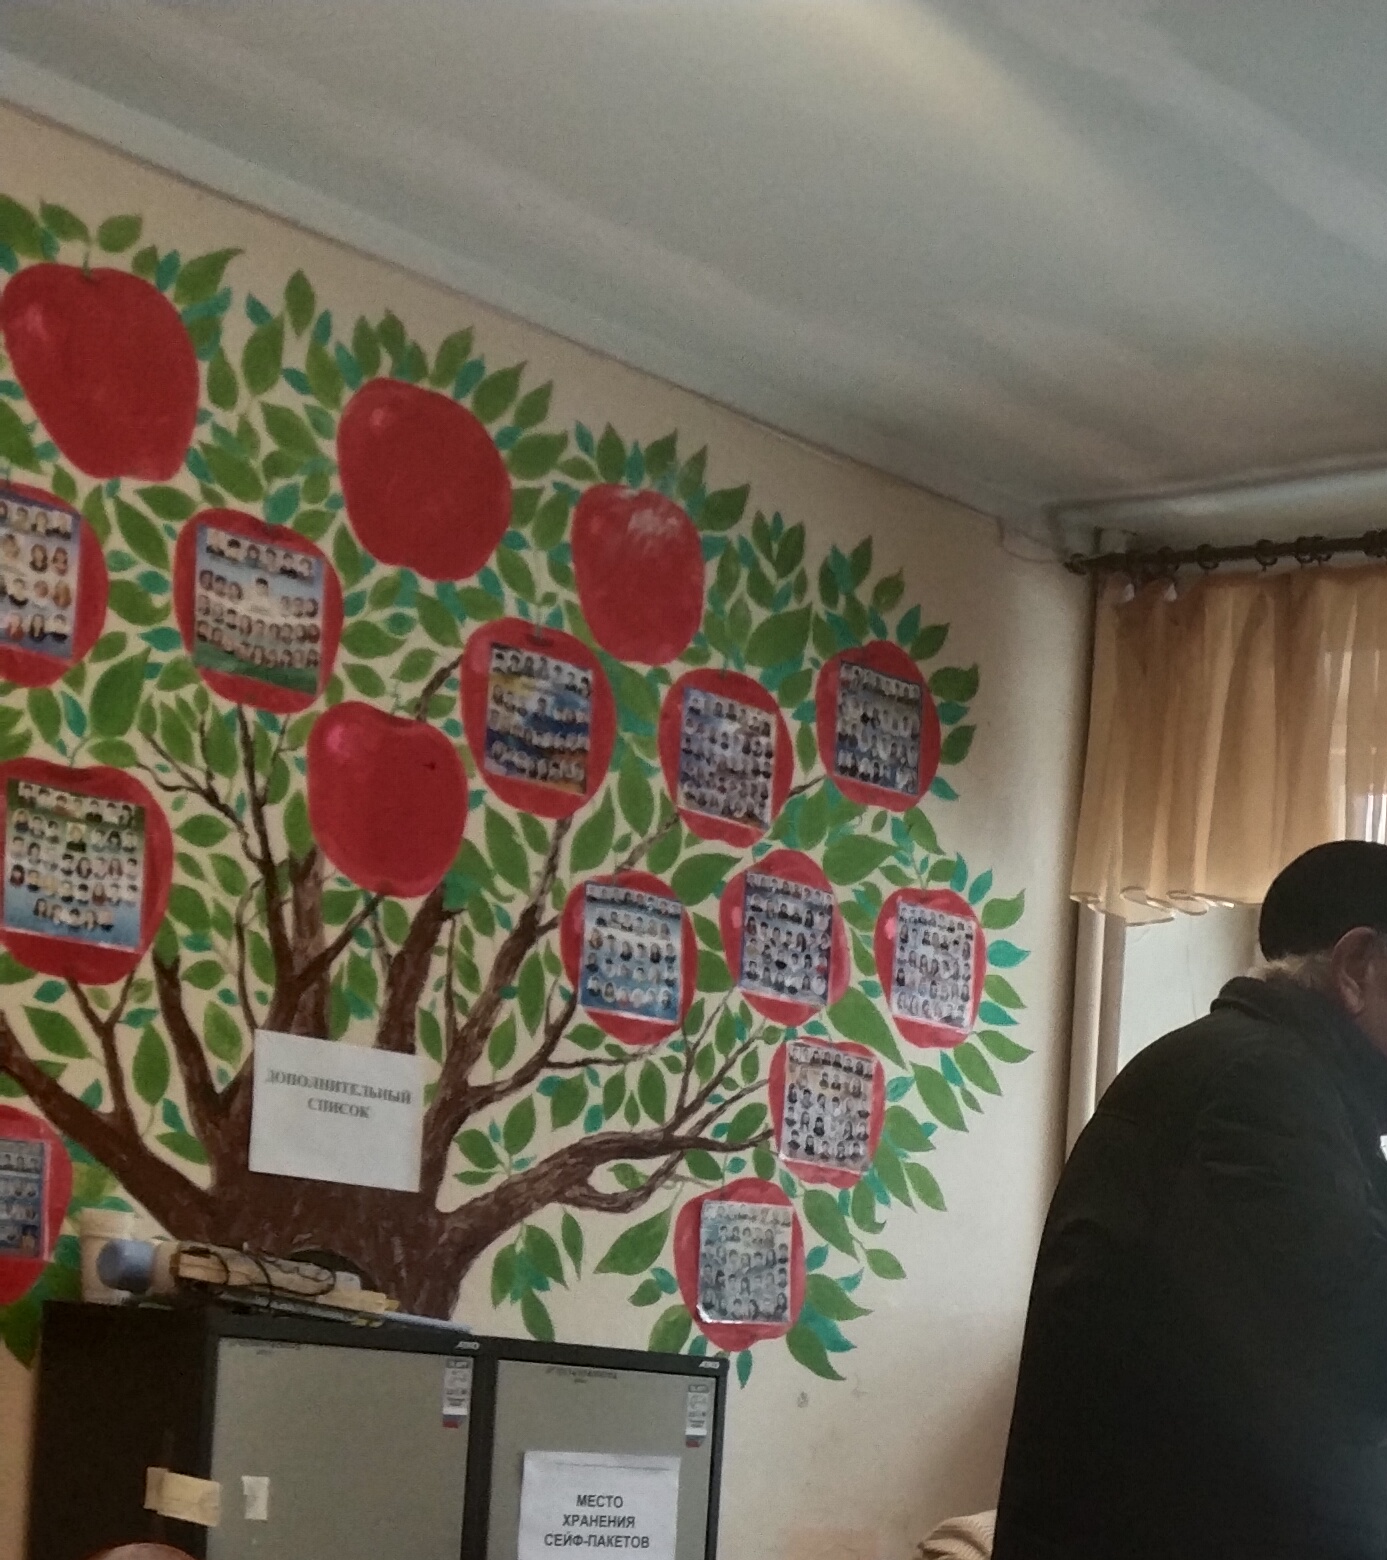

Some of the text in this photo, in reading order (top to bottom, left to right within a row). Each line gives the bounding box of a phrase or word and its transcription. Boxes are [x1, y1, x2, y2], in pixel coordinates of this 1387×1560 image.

[265, 1069, 412, 1105] ДОПОЛНИТЕЛЬНЫЙ
[307, 1097, 371, 1119] СПИСОК
[575, 1494, 624, 1508] МЕСТО
[562, 1514, 636, 1528] ХРАНЕНИЯ
[543, 1531, 650, 1549] СЕЙФ-ПАКЕТОВ
